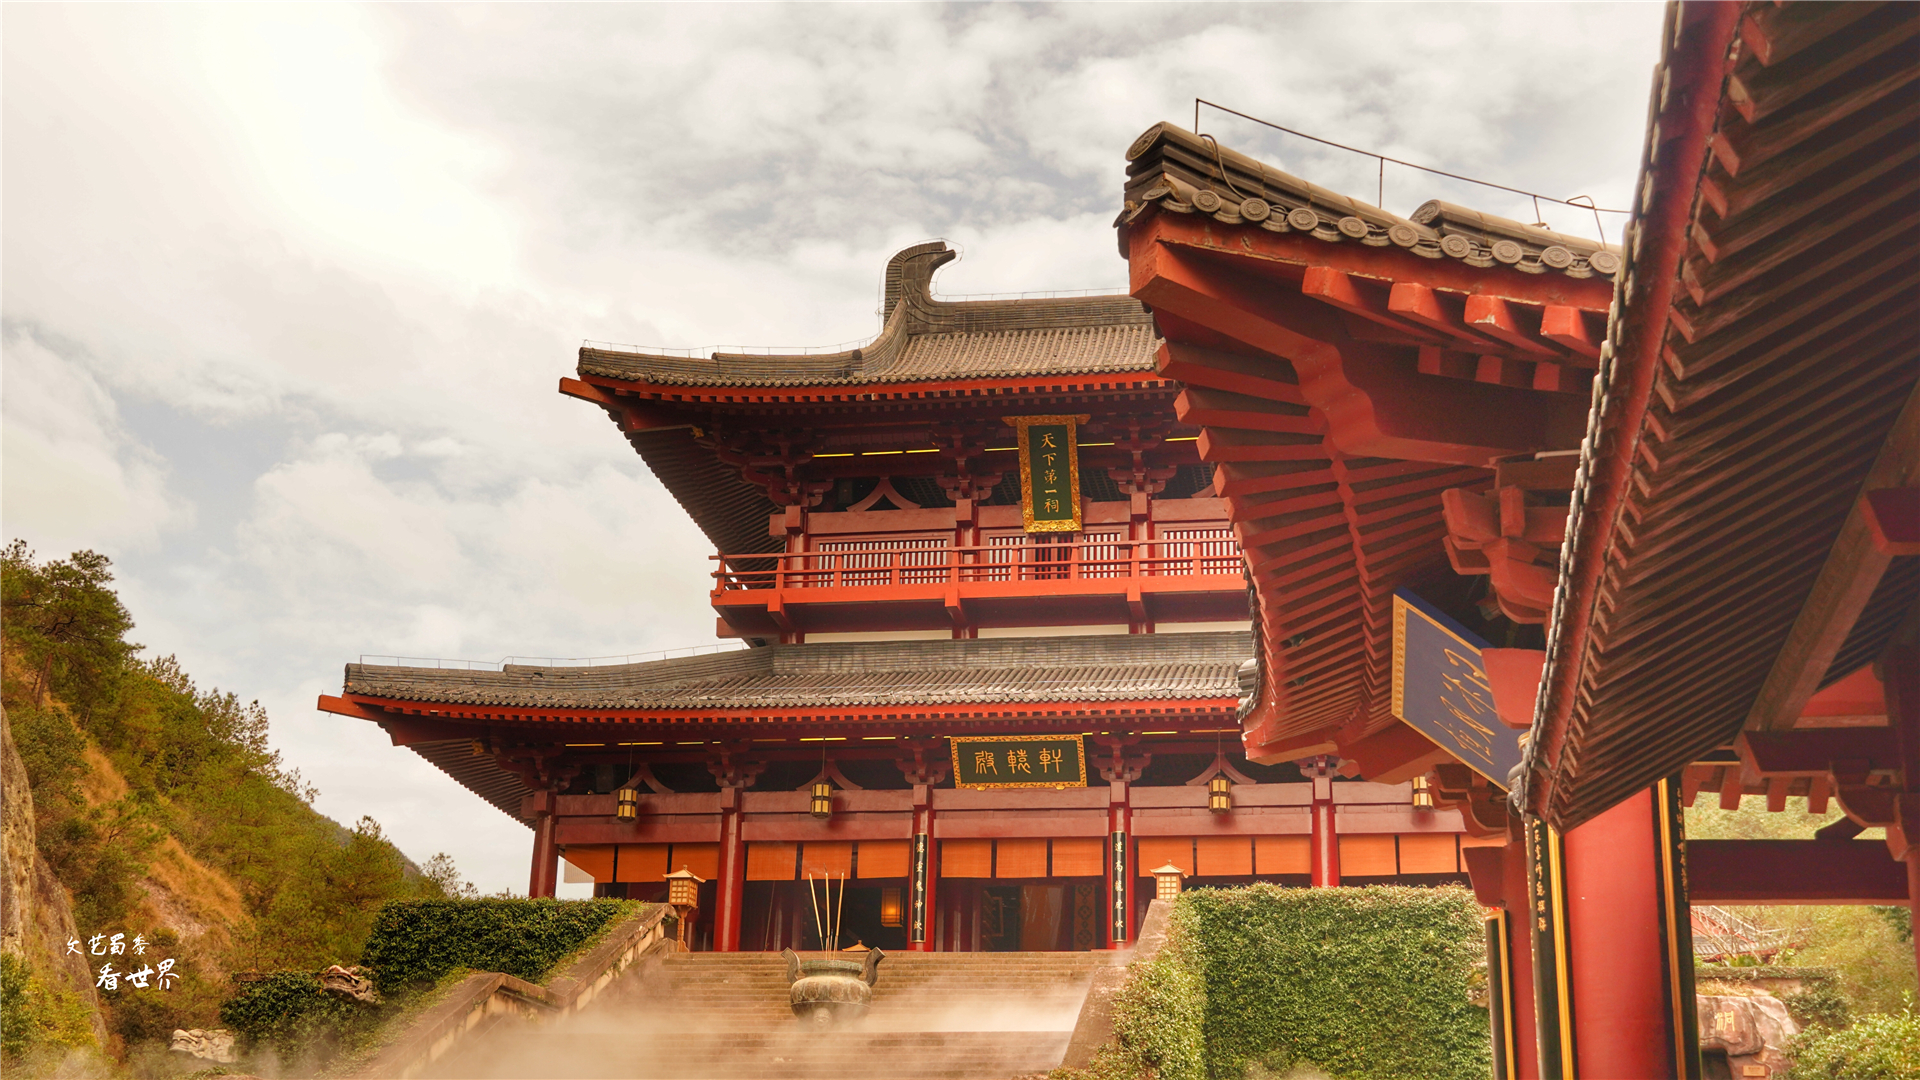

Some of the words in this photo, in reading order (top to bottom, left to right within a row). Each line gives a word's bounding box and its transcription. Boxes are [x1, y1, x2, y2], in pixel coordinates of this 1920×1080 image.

[1040, 432, 1060, 514] 天下第一祠
